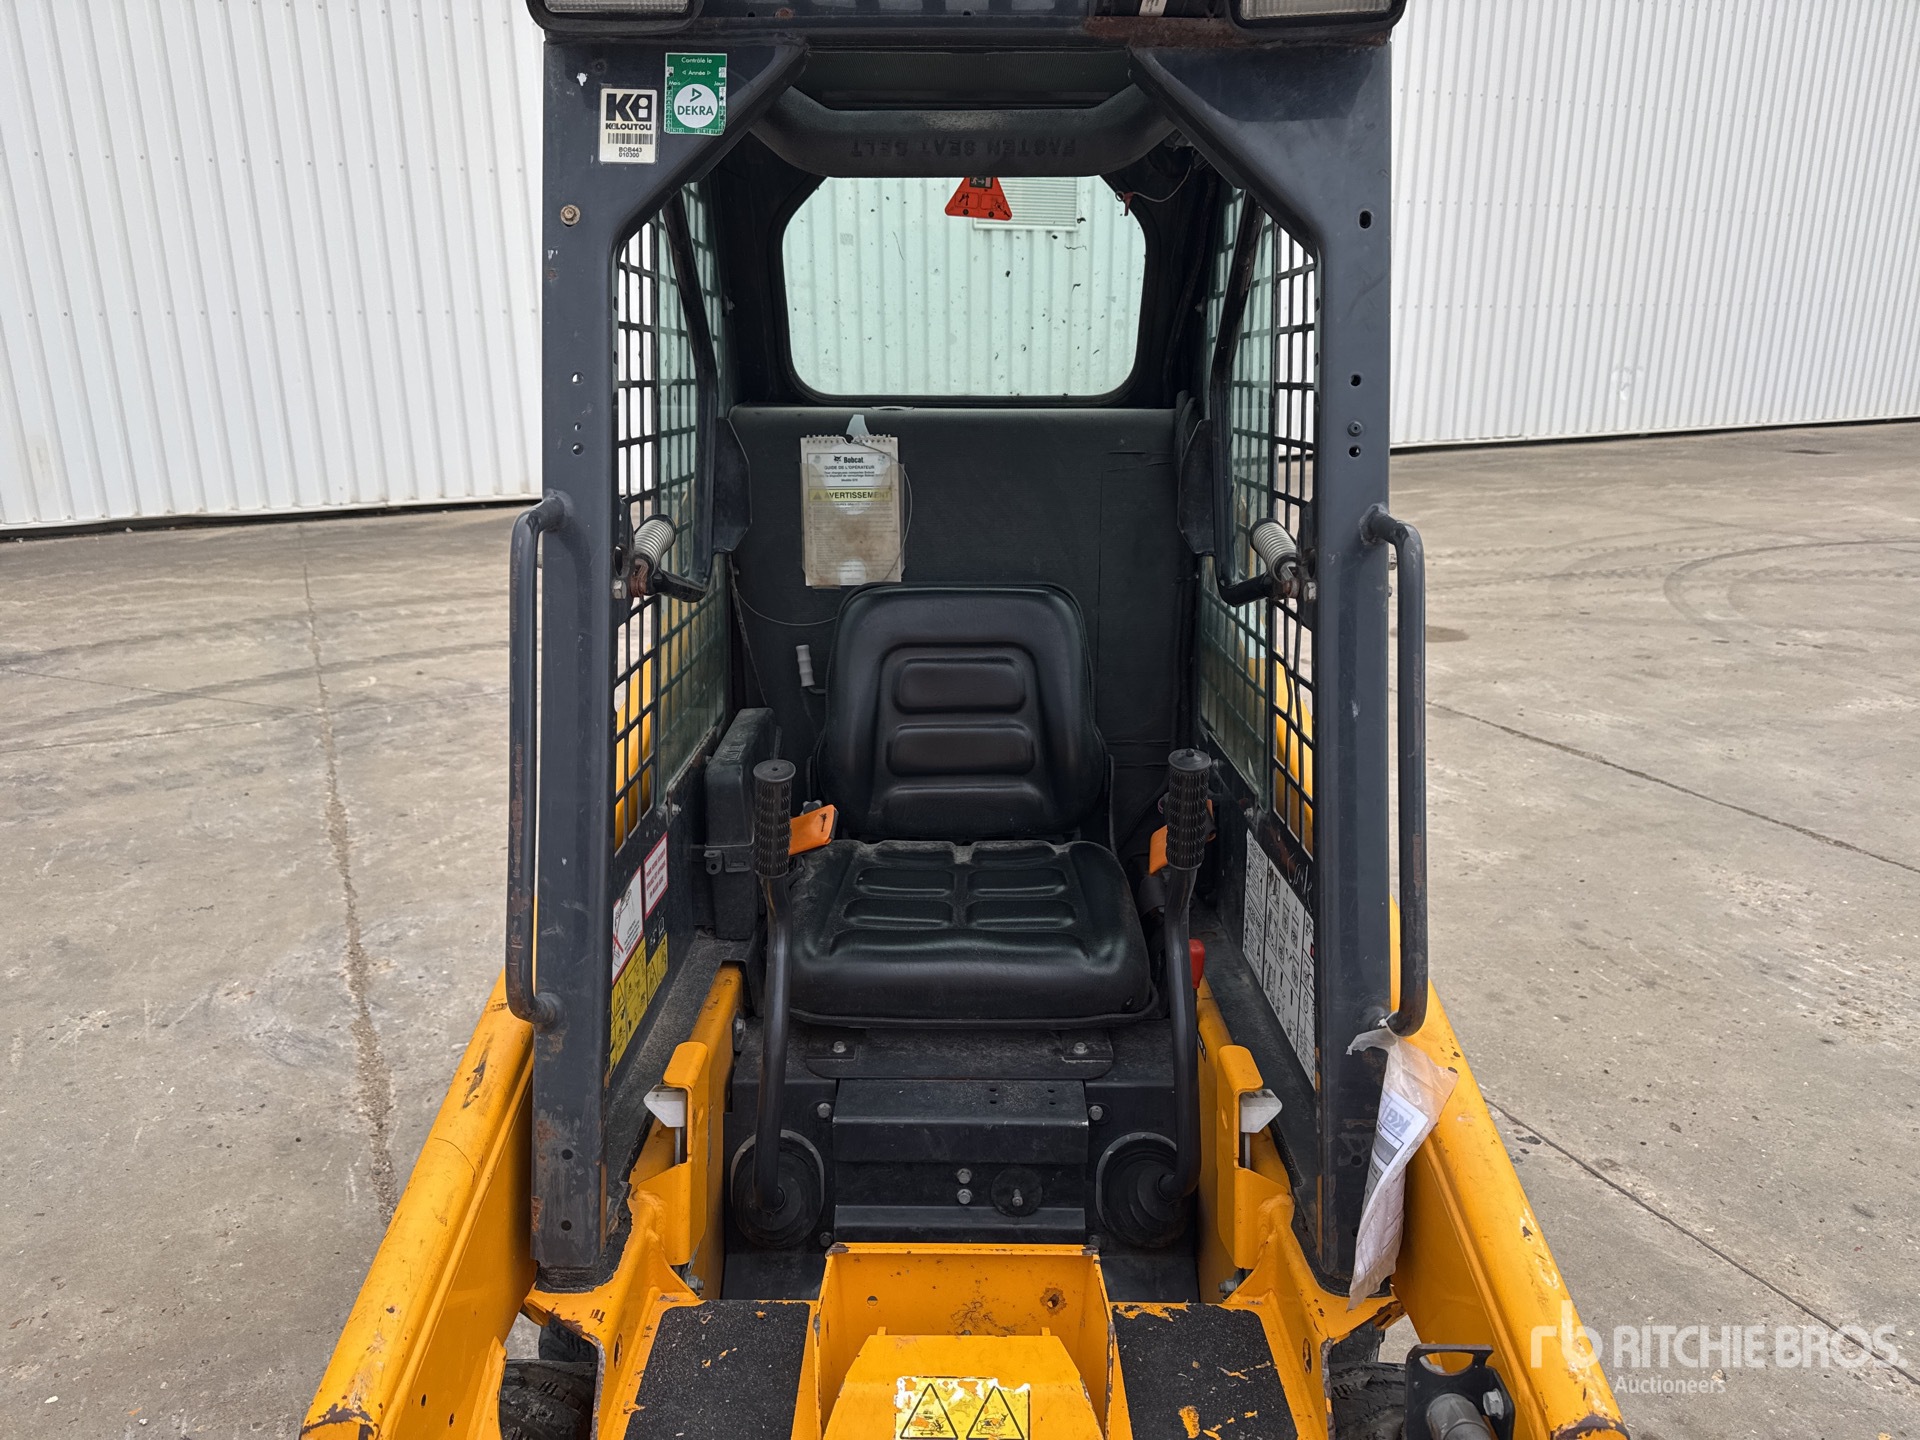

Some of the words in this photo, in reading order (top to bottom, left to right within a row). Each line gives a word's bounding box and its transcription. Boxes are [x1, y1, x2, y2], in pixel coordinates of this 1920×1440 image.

[677, 105, 714, 116] DEKRA
[920, 138, 977, 157] SEAT
[987, 138, 1076, 157] FASTEN
[843, 456, 864, 464] Bobcat
[824, 491, 890, 499] AVERTISSEMENT
